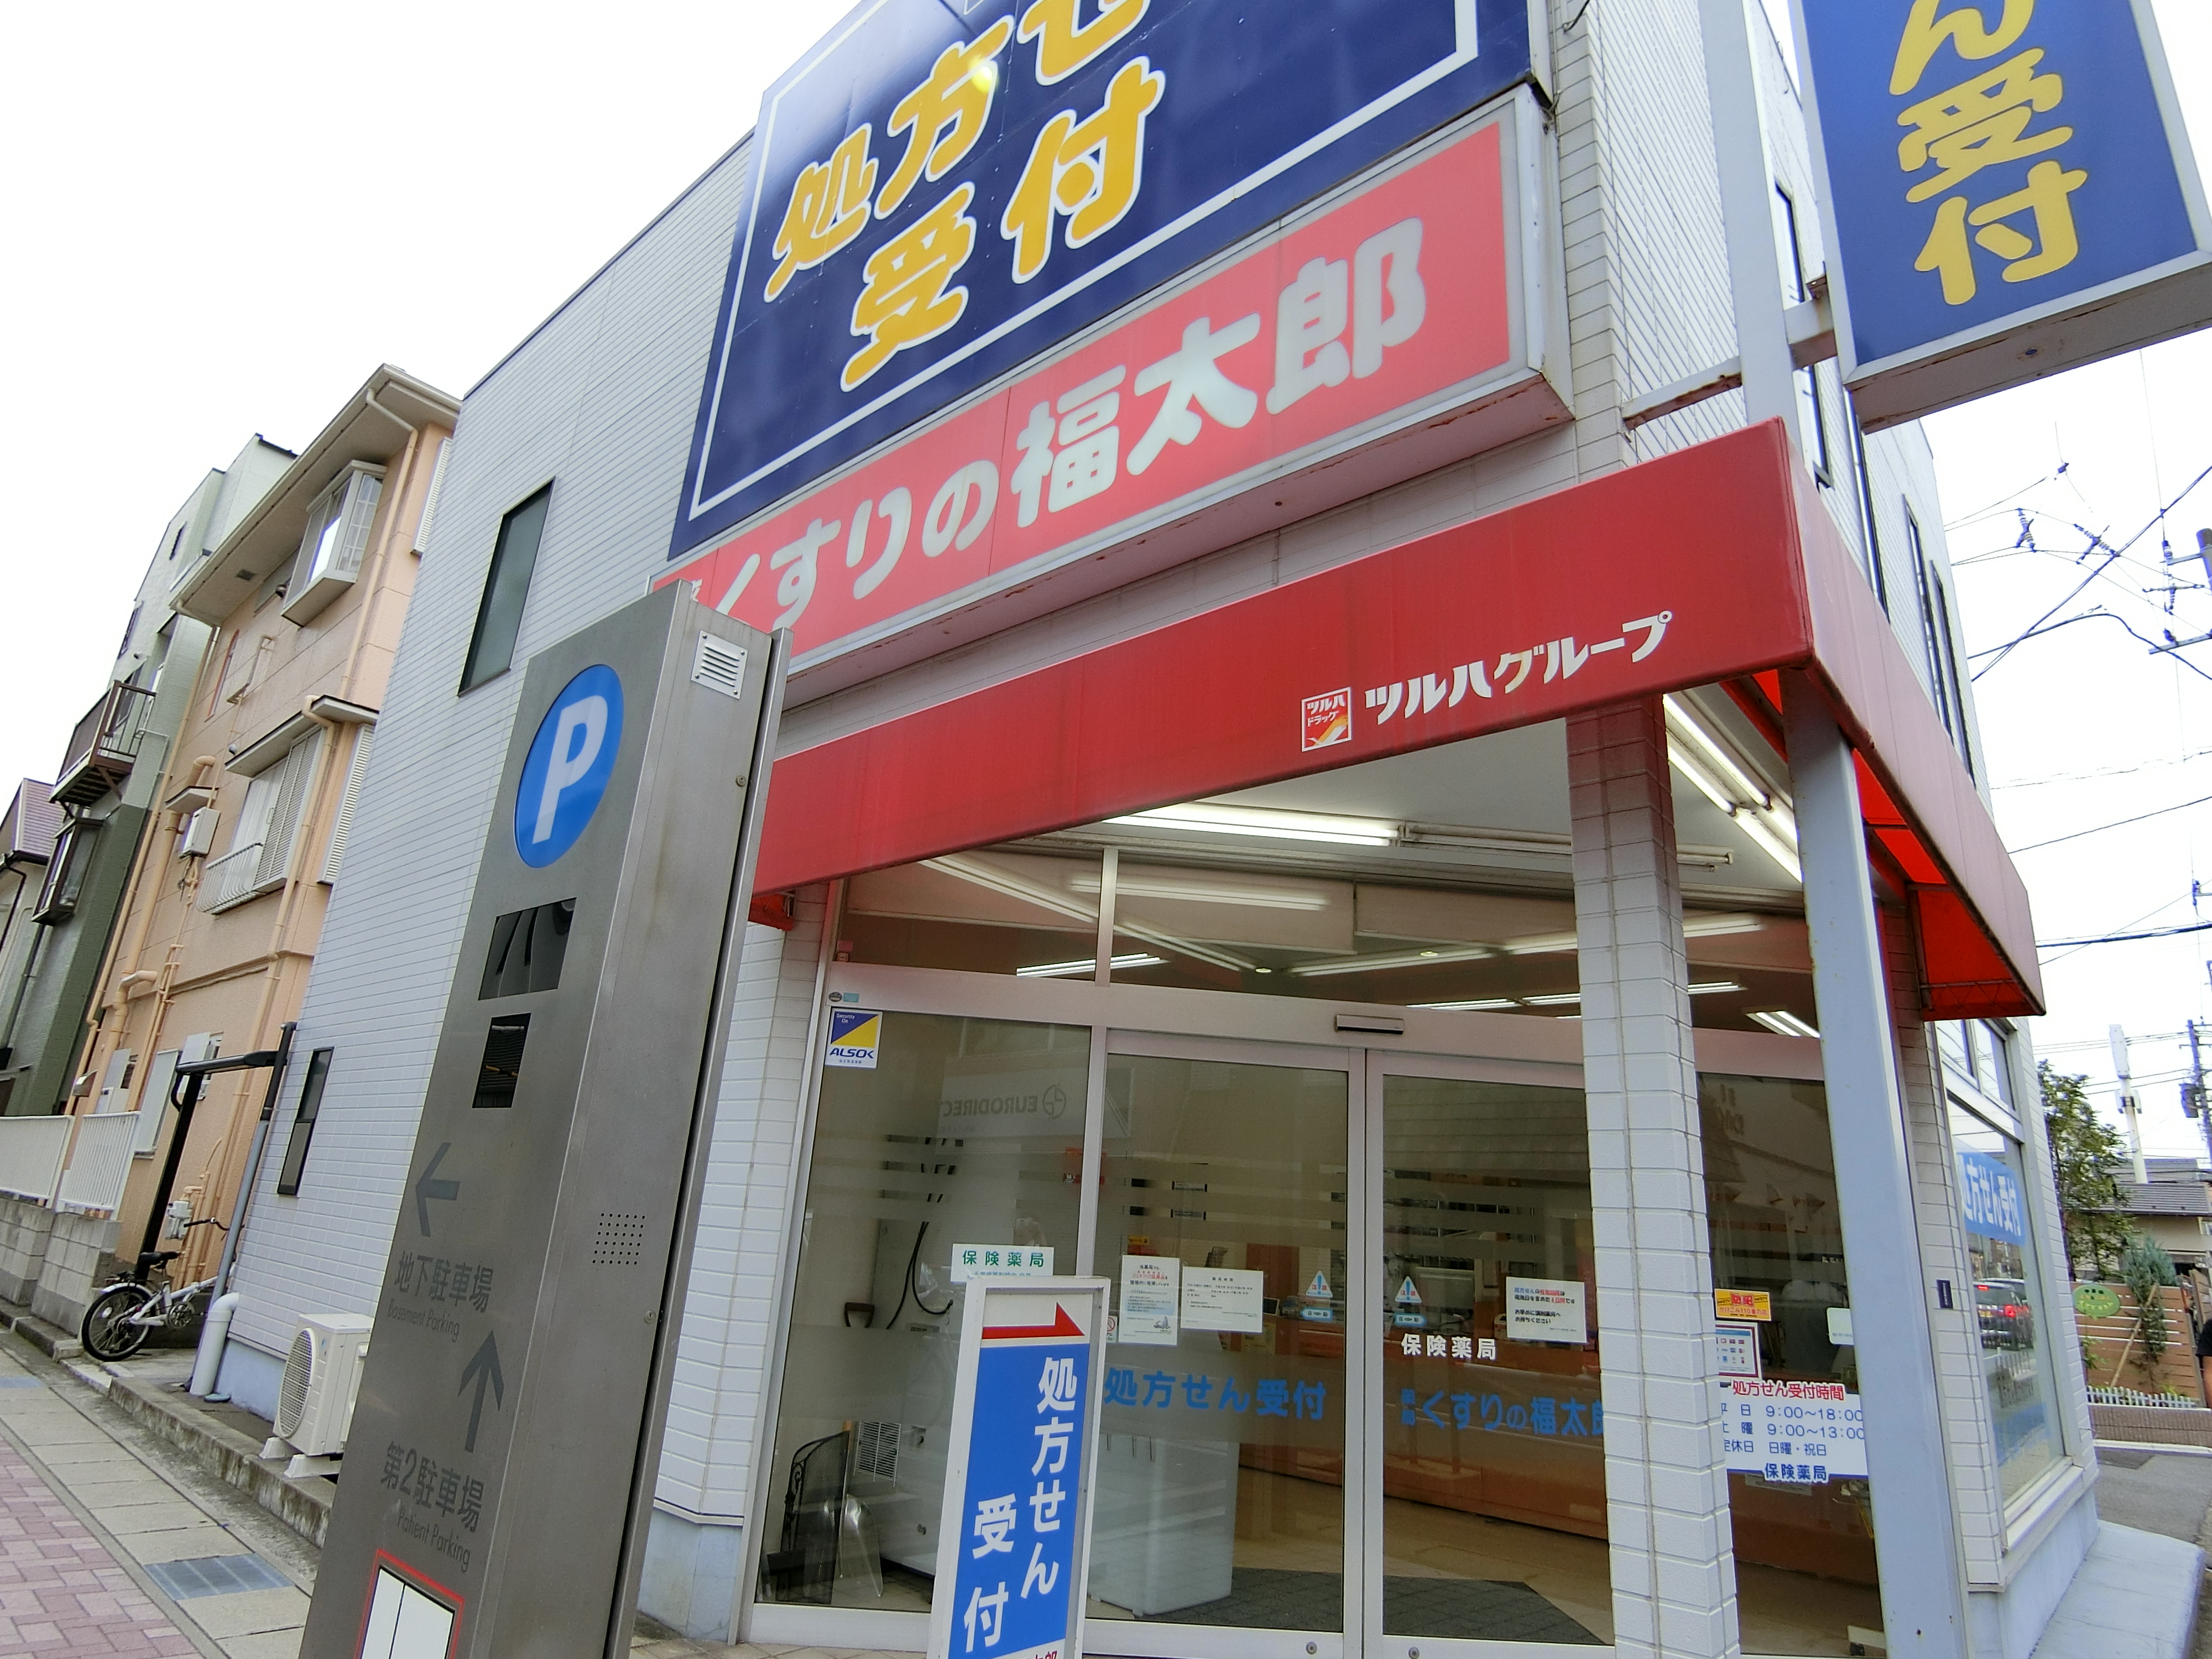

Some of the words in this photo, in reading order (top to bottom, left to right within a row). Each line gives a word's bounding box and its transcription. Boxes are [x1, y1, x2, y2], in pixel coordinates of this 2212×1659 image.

[1889, 0, 2088, 305] ん受付
[840, 55, 1166, 392] 受付
[1365, 610, 1673, 725] ツルハグループ
[1307, 694, 1345, 716] ツルハ
[532, 695, 608, 844] P
[830, 1047, 874, 1059] ALSOK
[394, 1250, 494, 1313] 地下駐車場
[962, 1250, 1044, 1268] 保険薬局
[388, 1299, 426, 1326] Basement
[426, 1308, 461, 1343] Parking
[1401, 1333, 1497, 1360] 保険薬局
[1103, 1367, 1327, 1420] 処方せん受付
[1732, 1380, 1844, 1401] 処方せん受付時間
[1765, 1463, 1827, 1481] 保険薬局
[1769, 1441, 1827, 1456] 日曜・祝日
[381, 1441, 484, 1532] 第2駐車場
[1020, 1357, 1078, 1599] 処方せん
[397, 1506, 430, 1545] Patient
[430, 1523, 471, 1573] Parking
[963, 1493, 1017, 1652] 受付
